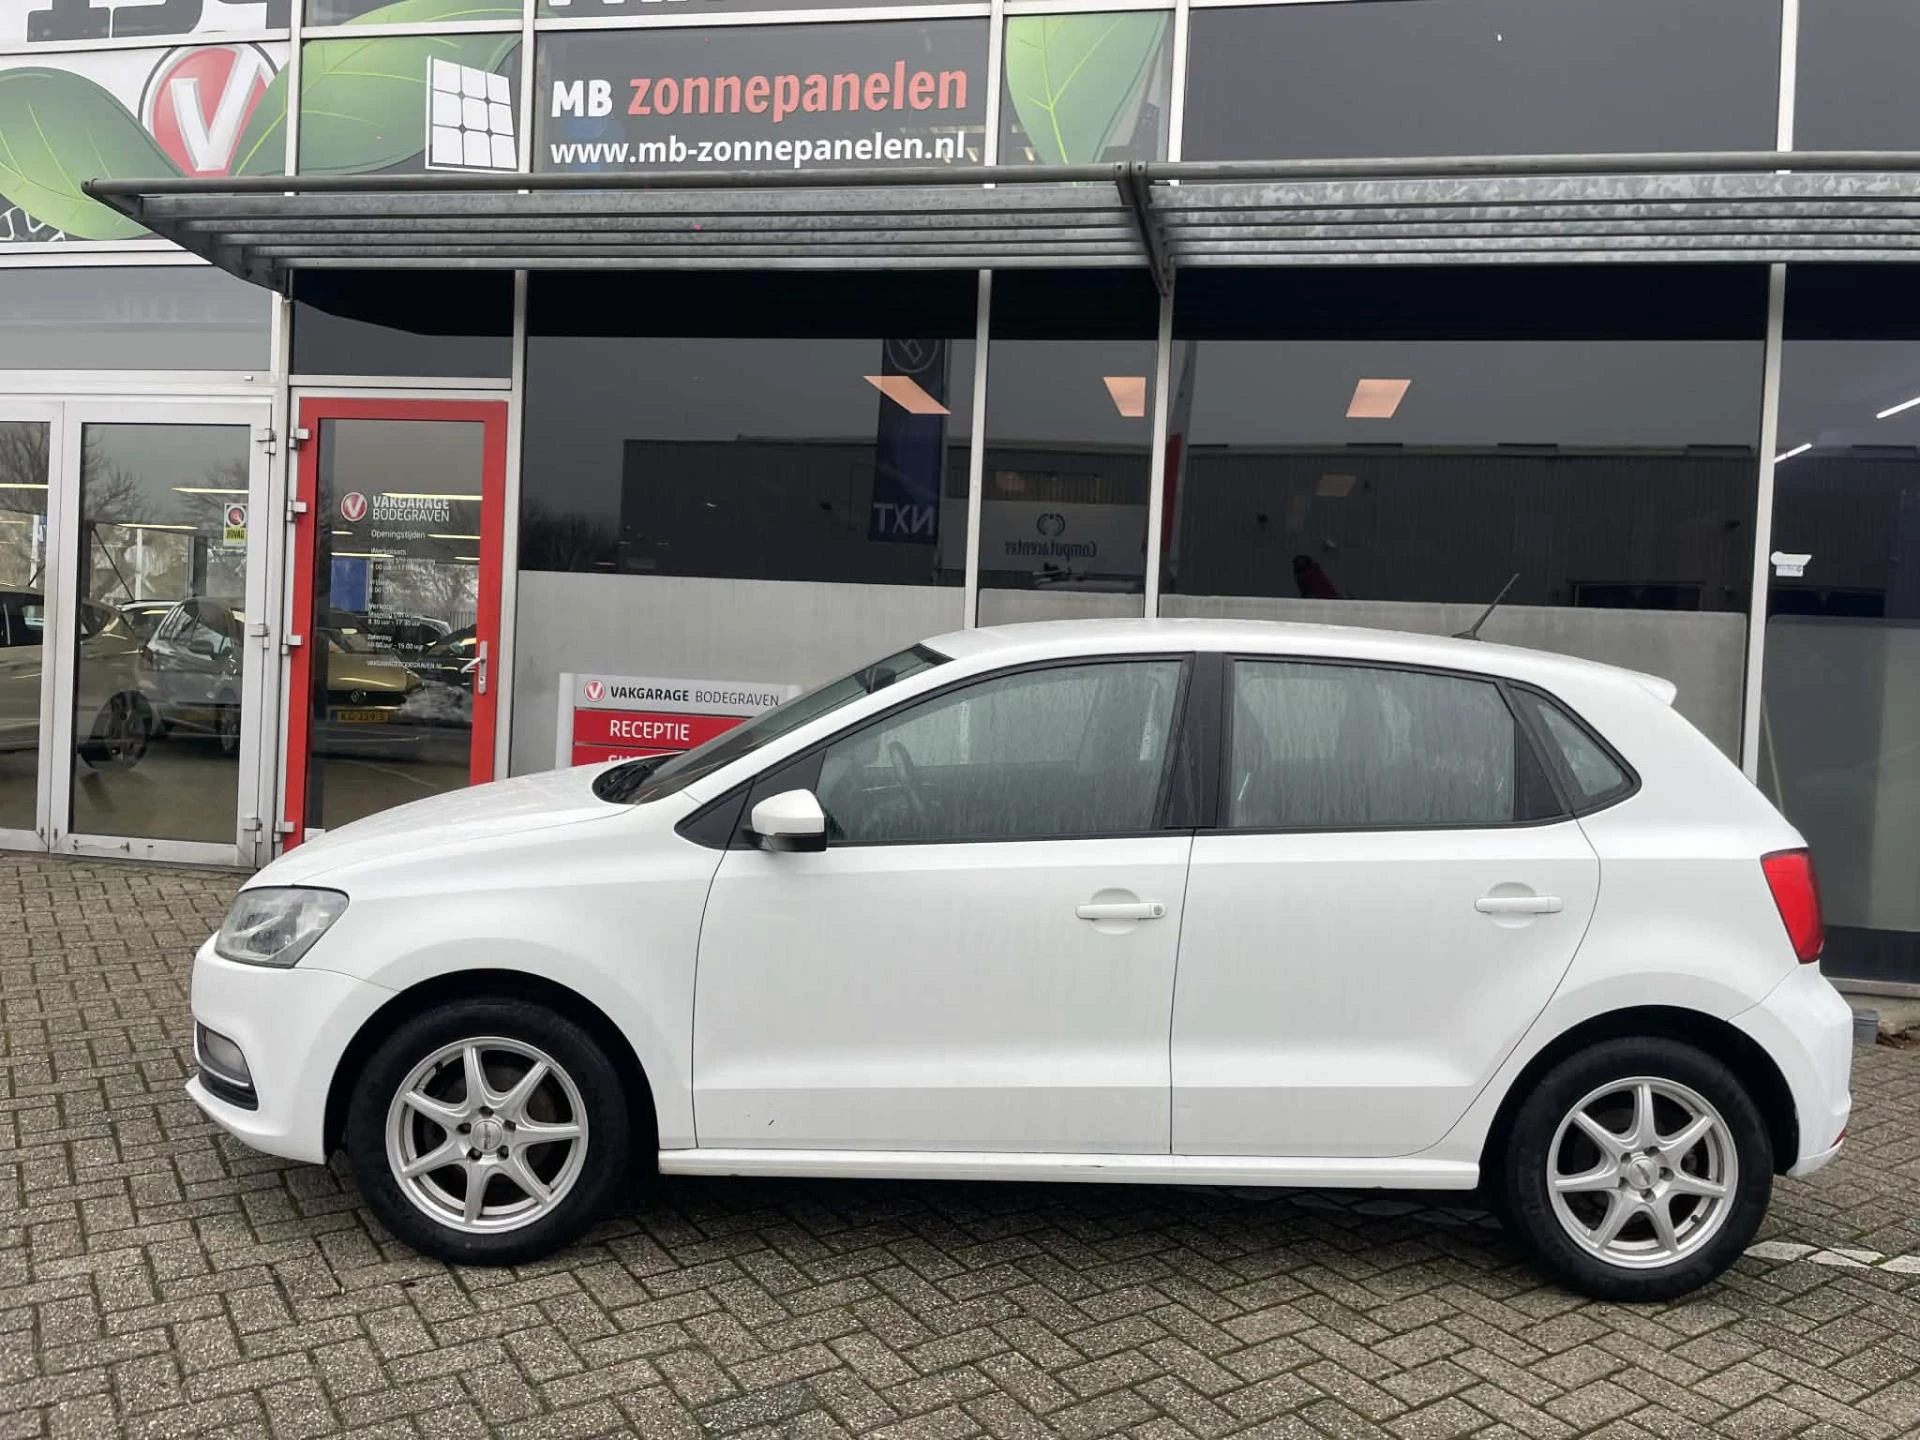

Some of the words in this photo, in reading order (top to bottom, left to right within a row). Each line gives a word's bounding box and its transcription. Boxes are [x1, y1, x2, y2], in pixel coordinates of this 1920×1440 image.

[551, 79, 613, 118] MB
[628, 60, 968, 123] zonnepanelen
[550, 130, 965, 169] www.mb-zonnepanelen.nl
[372, 495, 450, 510] VAKGARAGE
[372, 508, 450, 522] BODEGRAVEN
[371, 529, 426, 541] Openingstijden
[610, 686, 690, 702] VAKGARAGE
[695, 690, 780, 707] BODEGRAVEN
[609, 719, 691, 741] RECEPTIE
